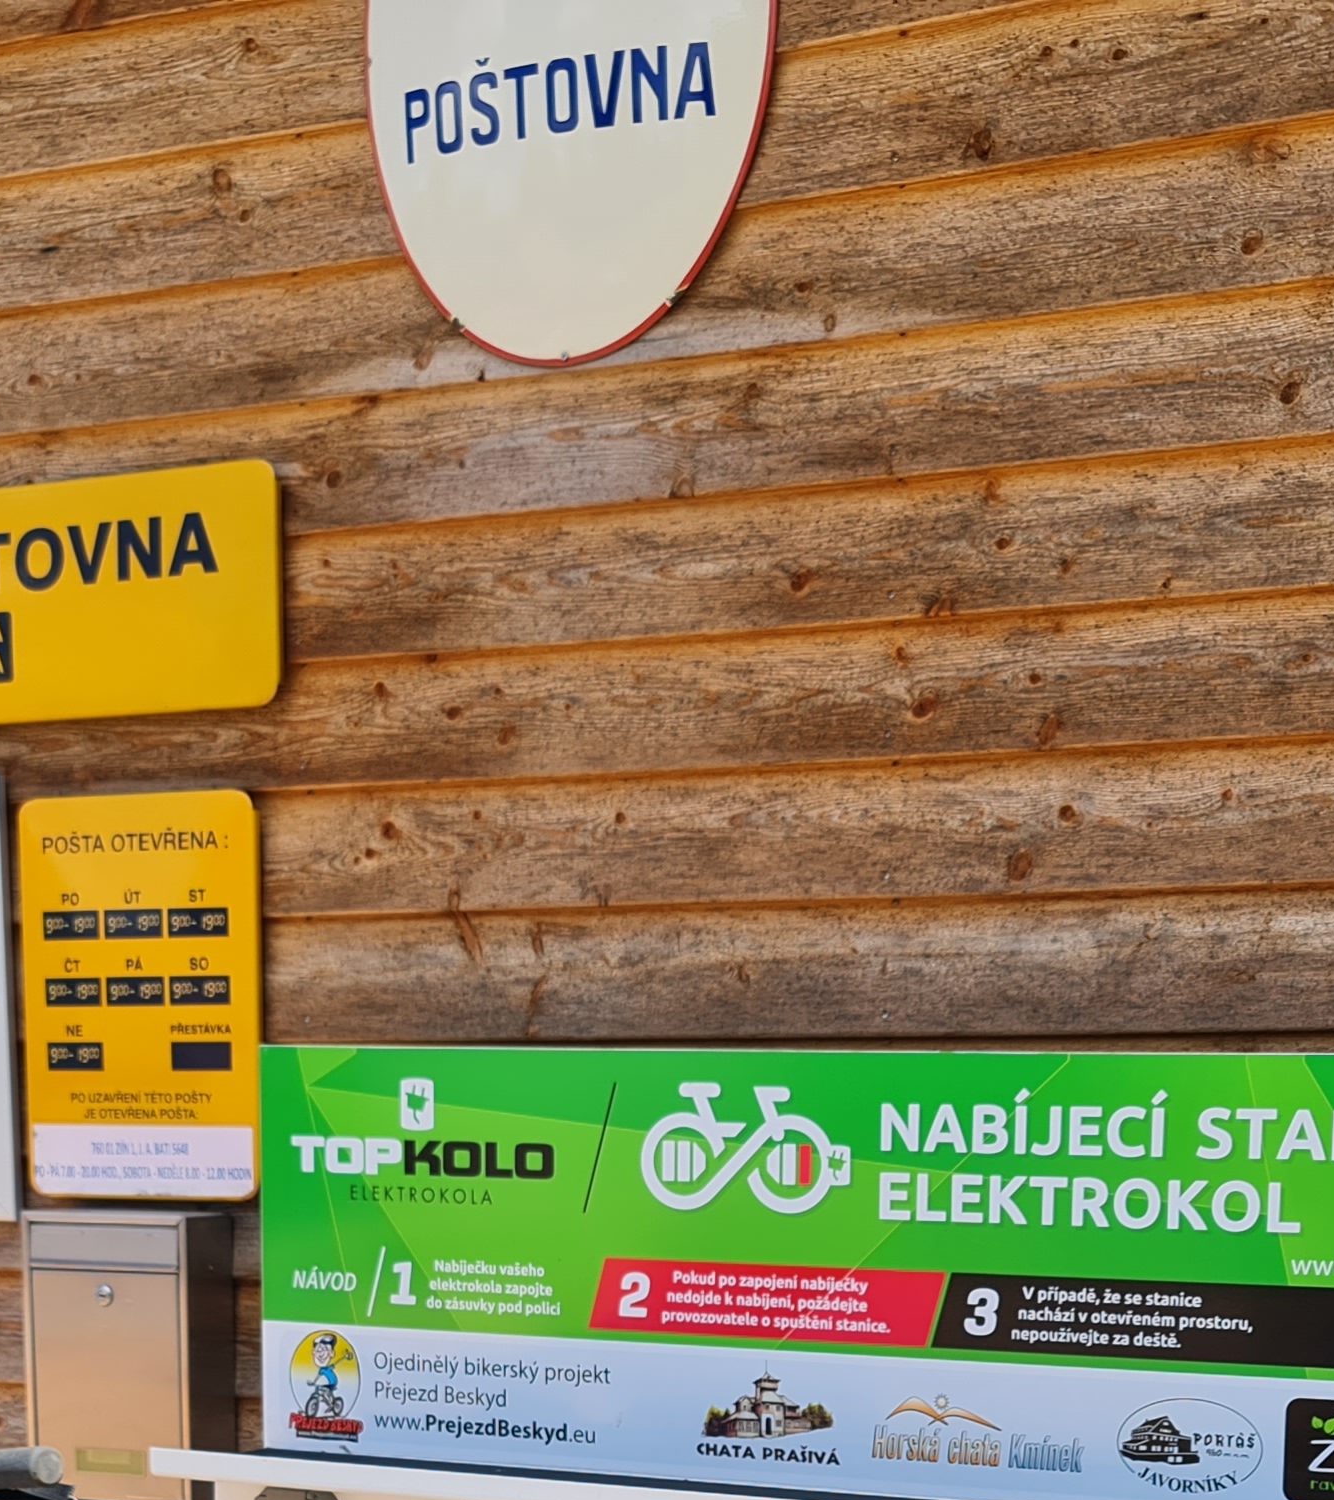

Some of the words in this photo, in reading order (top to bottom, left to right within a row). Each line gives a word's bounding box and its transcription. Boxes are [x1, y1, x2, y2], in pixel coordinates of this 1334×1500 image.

[405, 42, 716, 164] POŠTOVNA
[42, 832, 105, 854] POŠTA
[111, 828, 218, 852] OTEVŘENA
[61, 893, 79, 906] PO
[124, 889, 141, 904] ÚT
[189, 889, 206, 902] ST
[64, 957, 80, 973] ČT
[126, 957, 143, 971] PÁ
[190, 957, 209, 970] SO
[66, 1025, 83, 1036] NE
[170, 1023, 232, 1035] PŘESTÁVKA
[71, 1093, 85, 1103] PO
[88, 1091, 141, 1103] UZAVŘENÍ
[144, 1091, 172, 1103] TÉTO
[176, 1090, 212, 1104] POŠTY
[84, 1109, 97, 1120] JE
[100, 1107, 158, 1119] OTEVŘENA
[878, 1088, 1168, 1158] NABÍJECÍ
[350, 1185, 493, 1205] ELEKTROKOLA
[878, 1172, 1301, 1234] ELEKTROKOL
[434, 1259, 496, 1276] Nabíječku
[499, 1260, 545, 1277] vašeho
[293, 1266, 357, 1292] NÁVOD
[390, 1262, 417, 1305] 1
[429, 1279, 503, 1295] elektrokola
[505, 1281, 553, 1299] zapojte
[618, 1272, 650, 1319] 2
[673, 1270, 716, 1287] Pokud
[718, 1275, 736, 1290] po
[739, 1273, 798, 1293] zapojení
[801, 1275, 868, 1295] nabíječky
[426, 1296, 442, 1309] do
[445, 1297, 495, 1314] zásuvky
[498, 1299, 523, 1315] pod
[667, 1290, 722, 1309] nedojde
[725, 1291, 733, 1306] k
[736, 1293, 795, 1312] nabíjení,
[798, 1296, 868, 1316] požádejte
[1022, 1286, 1034, 1300] V
[1037, 1286, 1100, 1306] případě,
[1103, 1288, 1121, 1304] že
[1124, 1293, 1142, 1305] se
[1145, 1292, 1202, 1308] stanice
[661, 1309, 758, 1329] provozovatele
[762, 1316, 771, 1327] o
[774, 1314, 833, 1335] spuštění
[836, 1318, 891, 1334] stanice.
[963, 1287, 999, 1337] 3
[1018, 1306, 1075, 1323] nachází
[1078, 1311, 1088, 1323] v
[1091, 1309, 1175, 1327] otevřeném
[1179, 1315, 1253, 1334] prostoru,
[1011, 1327, 1109, 1347] nepoužívejte
[1112, 1333, 1130, 1346] za
[1133, 1331, 1181, 1348] deště.
[373, 1351, 459, 1379] Ojedinělý
[464, 1356, 540, 1382] bikerský
[544, 1363, 611, 1386] projekt
[374, 1380, 438, 1406] Přejezd
[444, 1386, 507, 1409] Beskyd
[374, 1413, 597, 1445] www.PrejezdBeskyd.eu
[1193, 1432, 1256, 1449] PORTÁŠ
[696, 1442, 756, 1460] CHATA
[762, 1446, 841, 1466] PRAŠIVÁ
[872, 1425, 942, 1463] Horská
[948, 1431, 1001, 1467] chata
[1008, 1434, 1085, 1473] Kmínek
[1138, 1467, 1237, 1493] JAVORNÍKY
